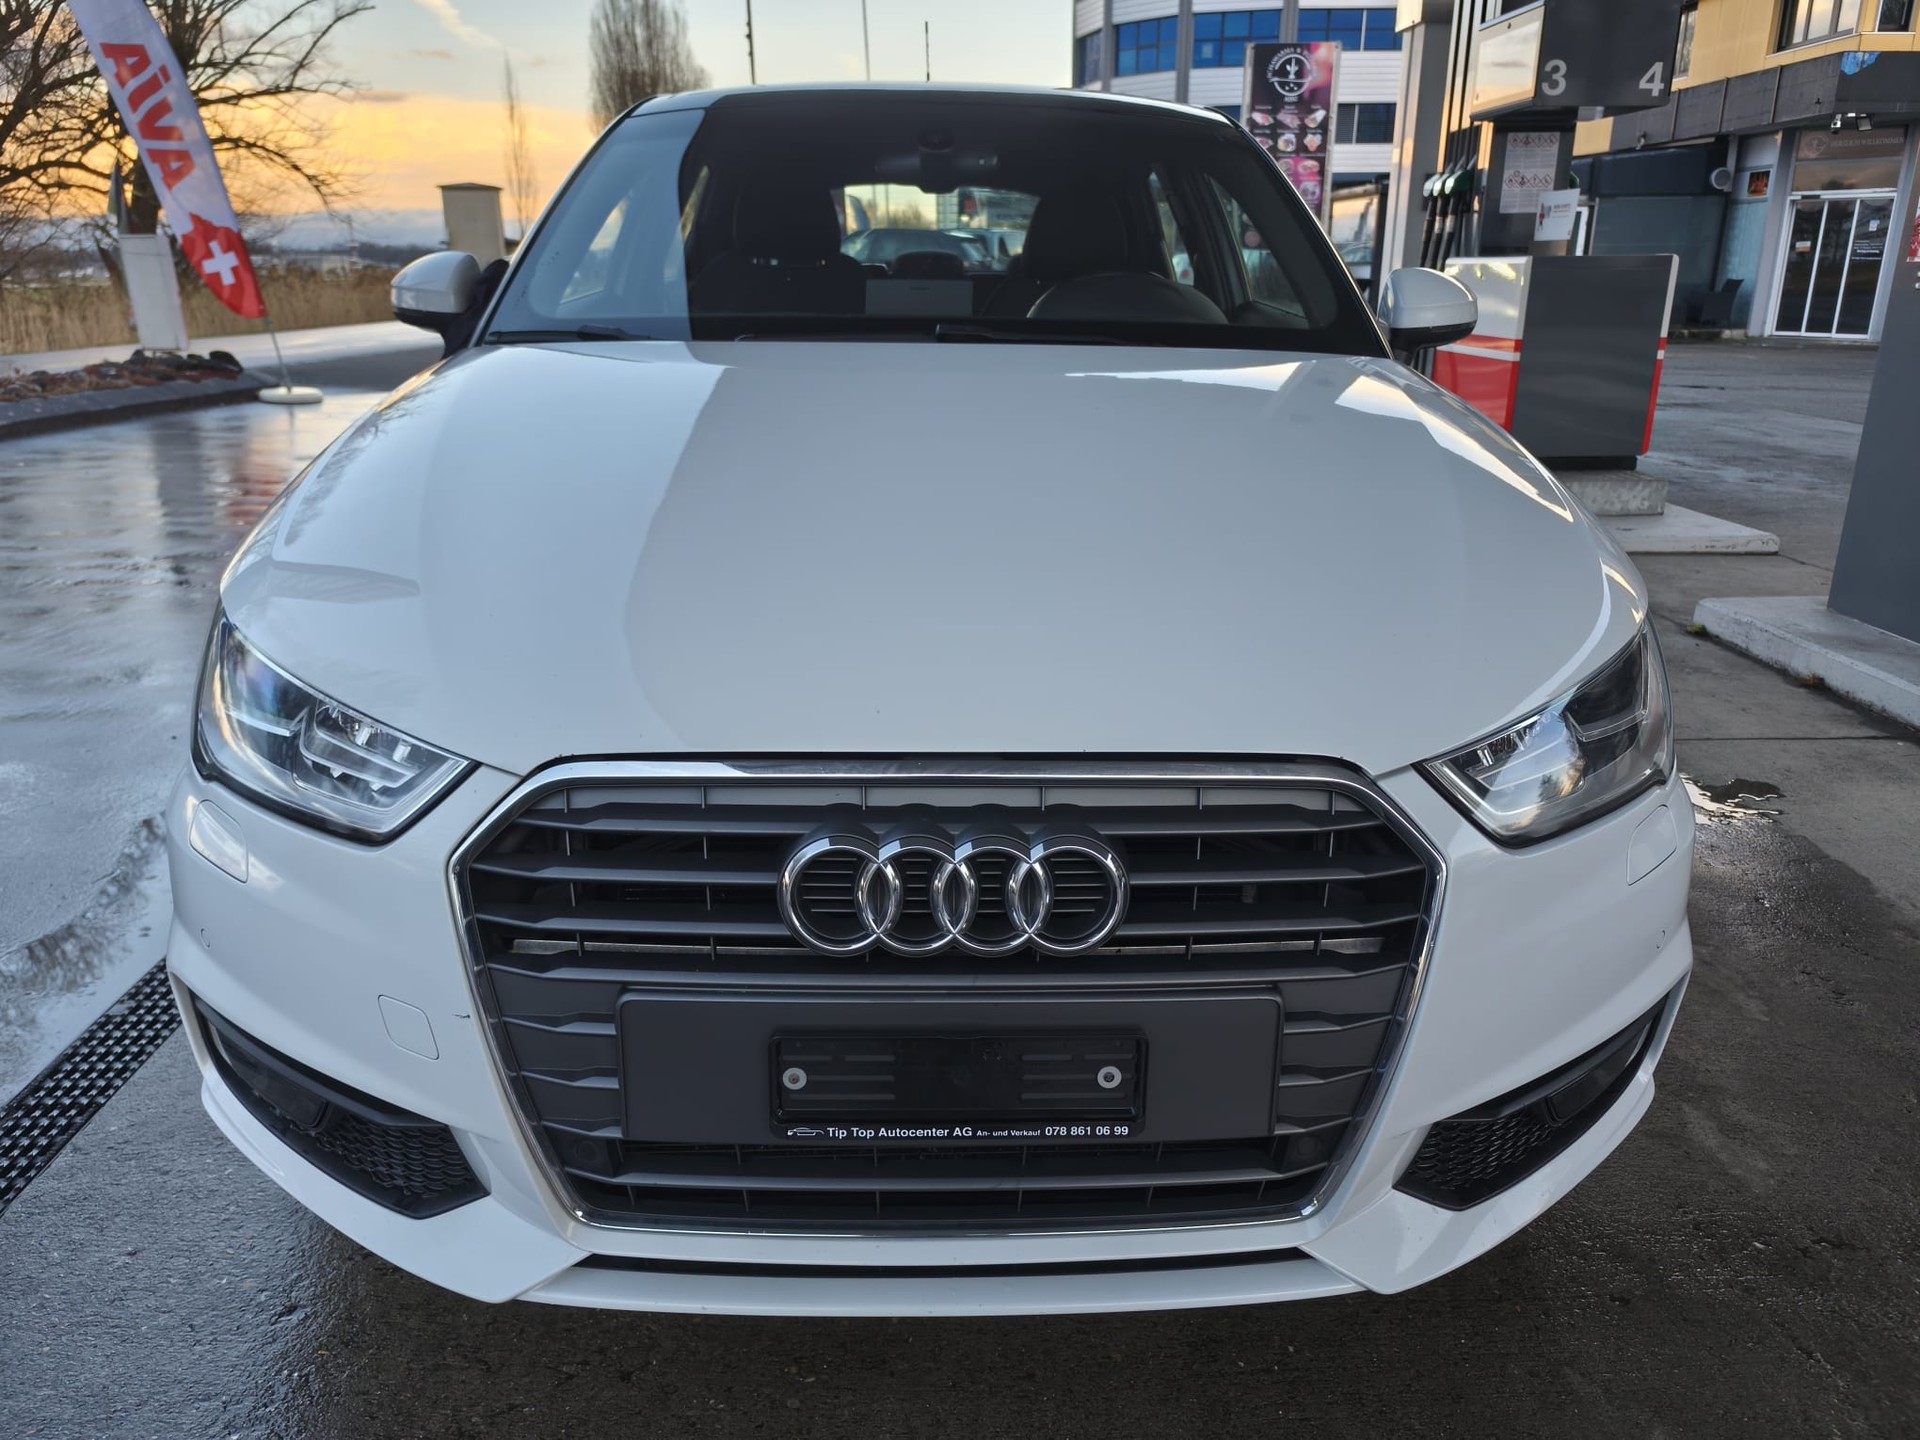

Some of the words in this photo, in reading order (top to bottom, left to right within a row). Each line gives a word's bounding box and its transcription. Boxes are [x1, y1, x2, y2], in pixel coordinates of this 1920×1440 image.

[1541, 58, 1567, 96] 3
[1638, 61, 1665, 97] 4
[826, 1127, 848, 1140] Tip
[850, 1127, 875, 1140] Top
[878, 1127, 950, 1138] Autocenter
[952, 1126, 973, 1137] AG
[976, 1129, 991, 1137] An-
[992, 1129, 1008, 1137] und
[1010, 1129, 1041, 1137] Verkauf
[1045, 1126, 1067, 1137] 078
[1070, 1126, 1092, 1136] 861
[1095, 1126, 1111, 1136] 06
[1113, 1125, 1129, 1136] 99
